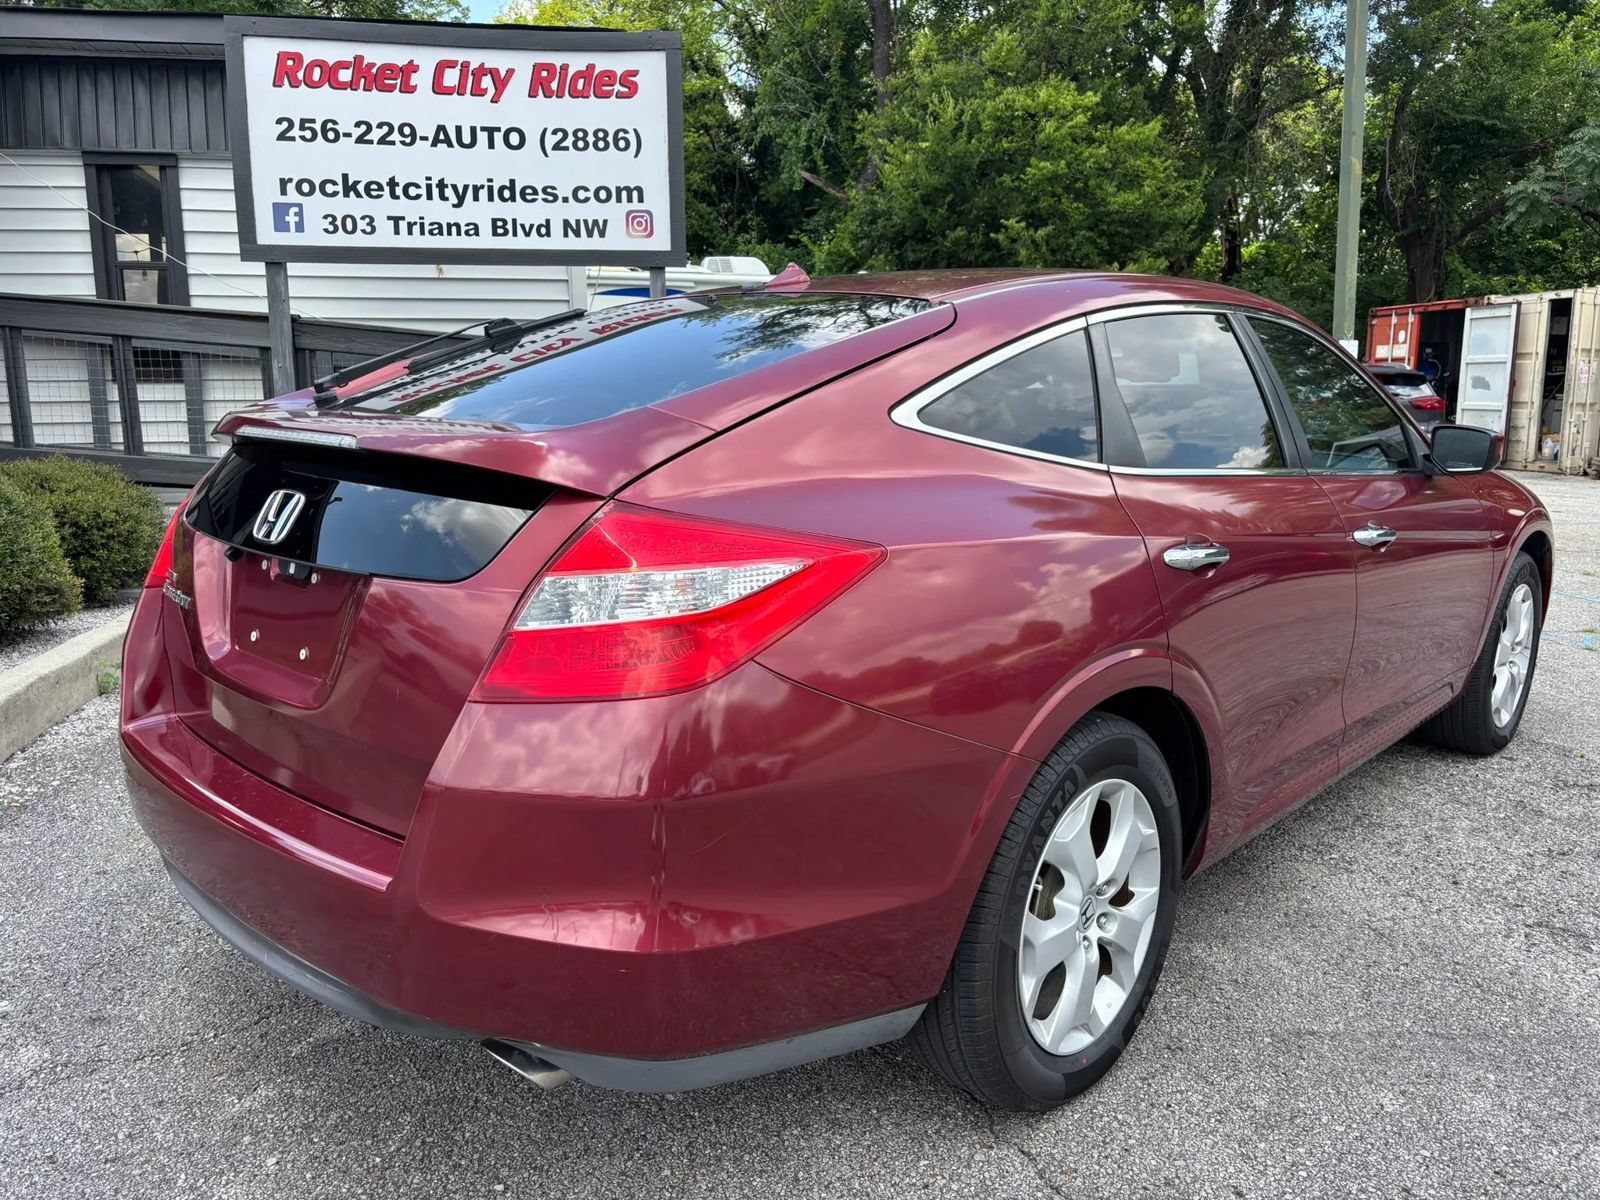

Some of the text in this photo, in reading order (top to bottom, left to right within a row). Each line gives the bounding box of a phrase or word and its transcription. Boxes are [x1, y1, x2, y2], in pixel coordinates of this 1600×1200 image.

[273, 51, 640, 103] Rocket City Rides
[275, 117, 642, 158] 256-229-AUTO (2886)
[279, 173, 645, 208] rocketcityrides.com
[322, 213, 608, 238] 303 Triana Blvd NW
